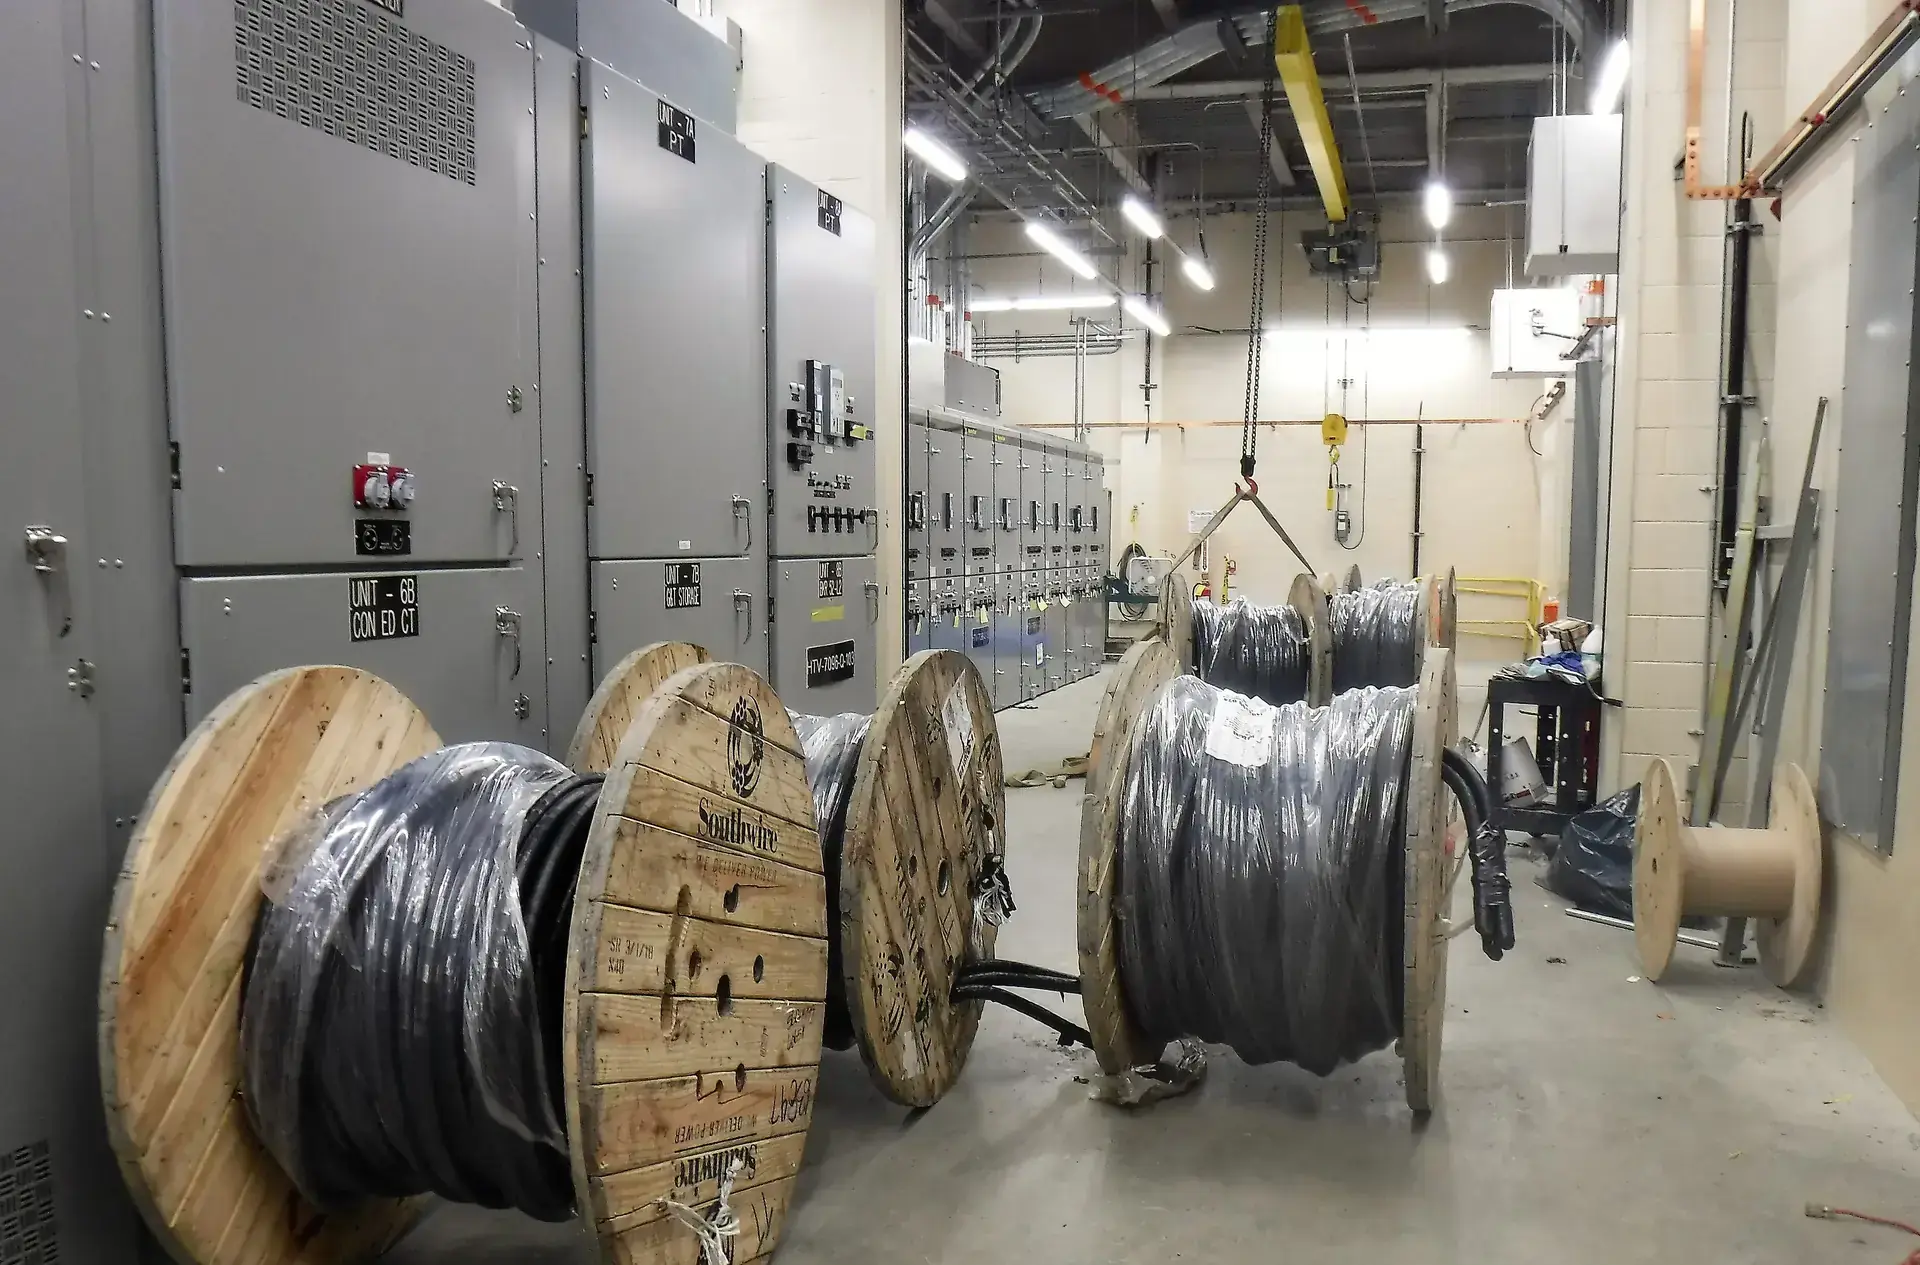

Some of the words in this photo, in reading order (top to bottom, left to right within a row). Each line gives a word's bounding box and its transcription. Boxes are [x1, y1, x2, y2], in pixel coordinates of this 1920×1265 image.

[658, 101, 674, 127] UNIT
[684, 115, 695, 139] 7A
[669, 130, 685, 155] PT
[825, 212, 835, 231] PT
[665, 565, 680, 585] UNIT
[691, 564, 700, 584] 7B
[351, 579, 379, 608] UNIT
[400, 578, 415, 604] 6B
[353, 611, 376, 638] CON
[381, 609, 396, 636] ED
[401, 608, 416, 634] CT
[697, 796, 779, 854] Southwire
